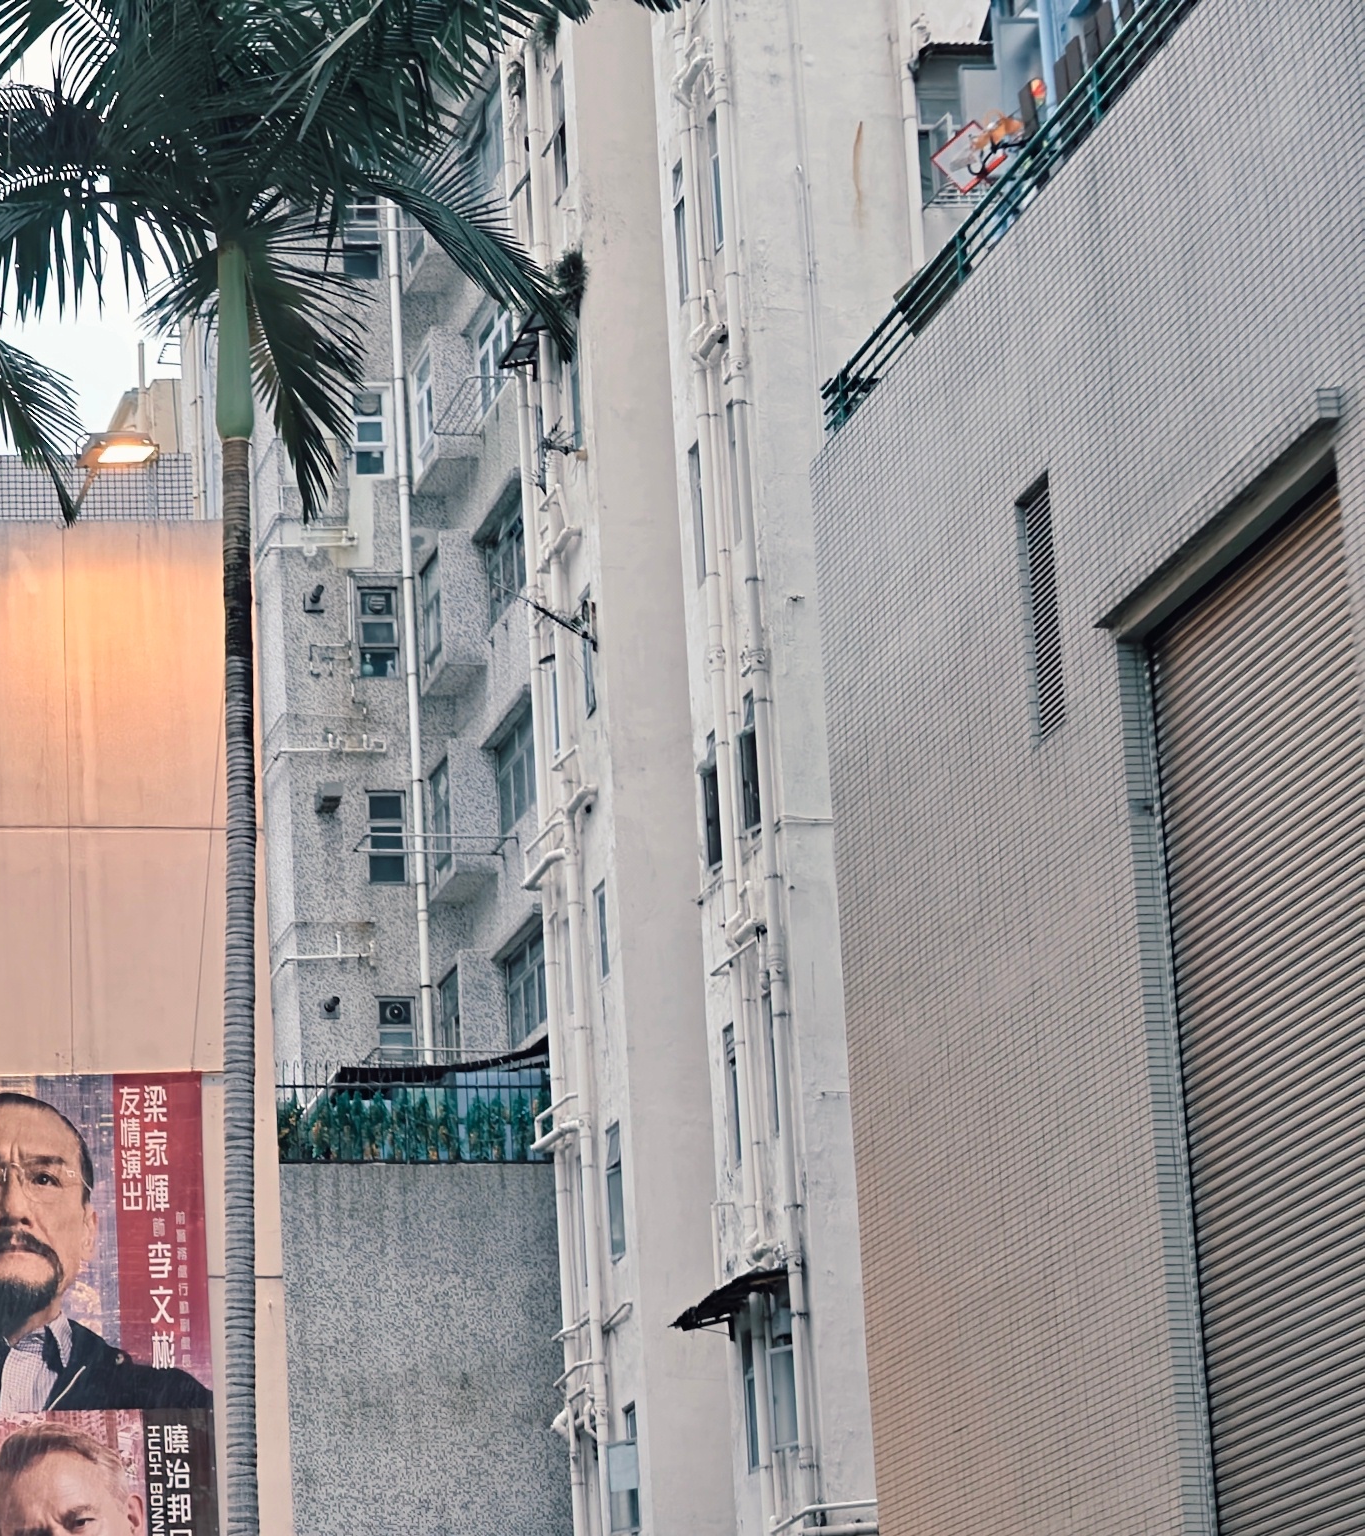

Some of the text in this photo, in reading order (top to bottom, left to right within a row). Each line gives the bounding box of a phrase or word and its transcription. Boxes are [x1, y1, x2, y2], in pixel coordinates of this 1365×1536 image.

[119, 1086, 143, 1212] 友情演出
[147, 1425, 163, 1477] HUGH
